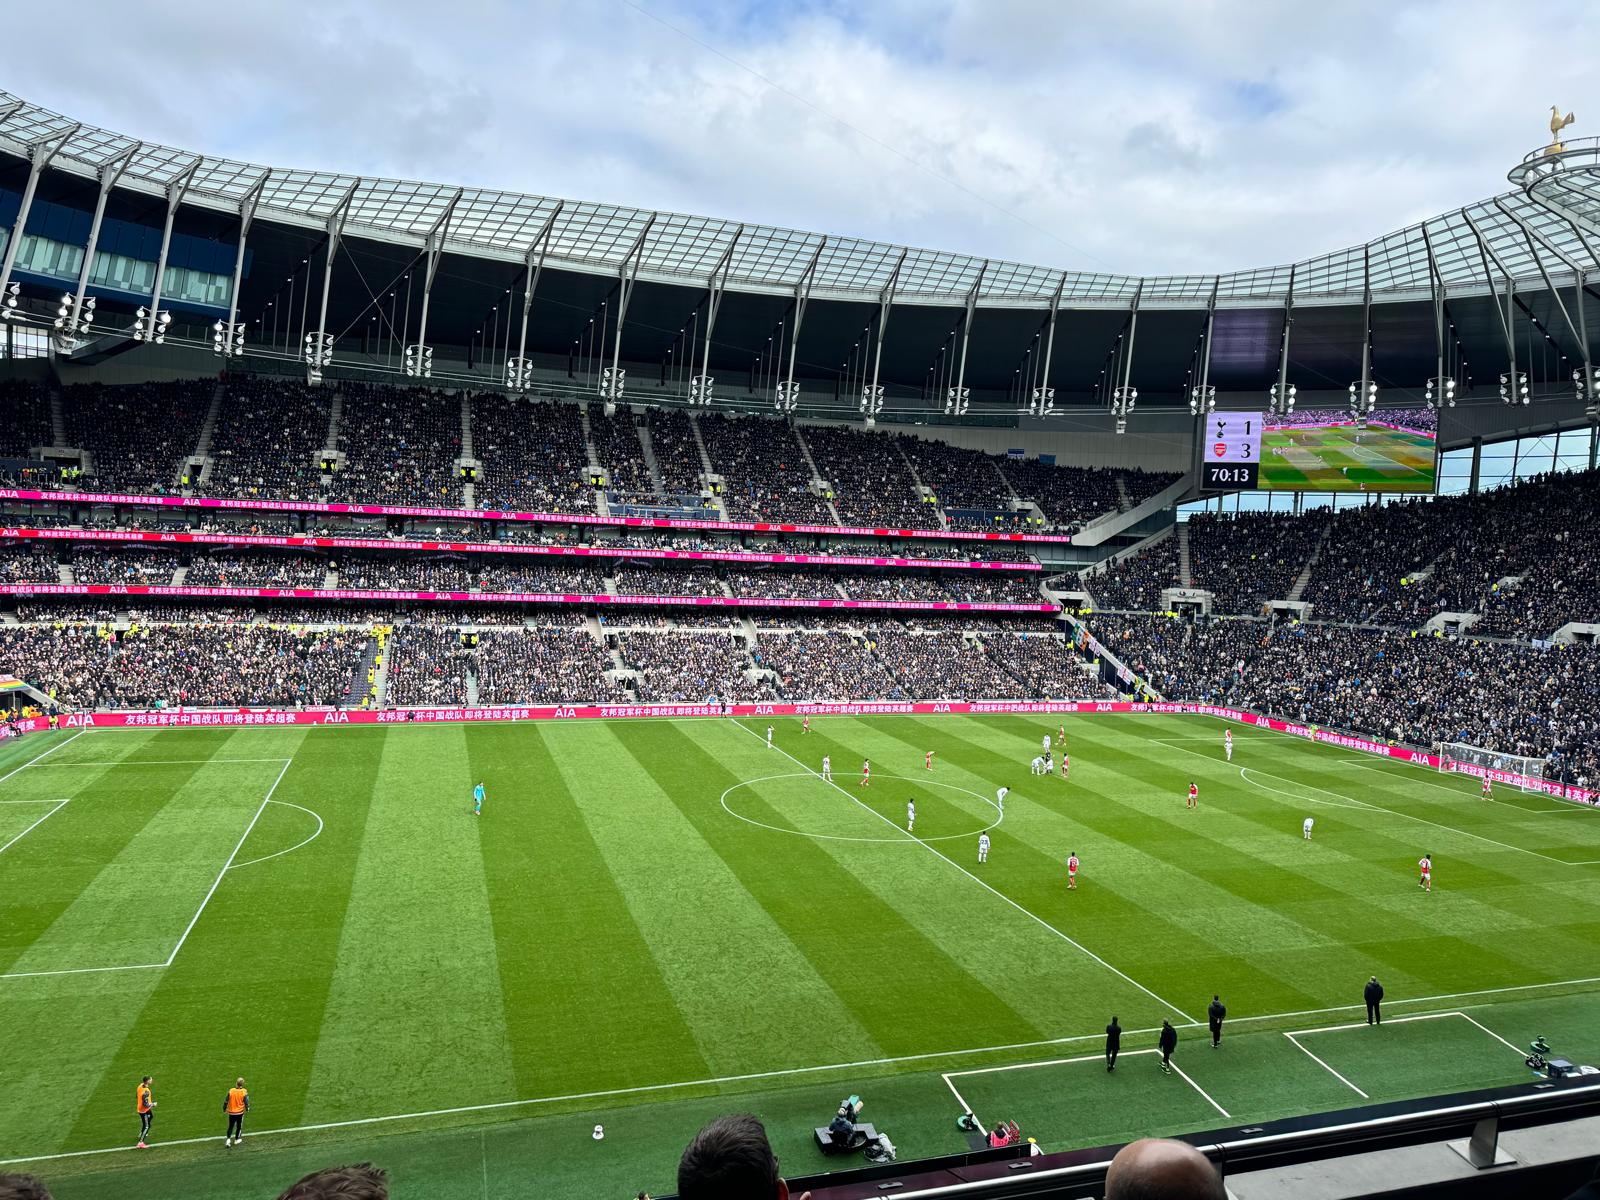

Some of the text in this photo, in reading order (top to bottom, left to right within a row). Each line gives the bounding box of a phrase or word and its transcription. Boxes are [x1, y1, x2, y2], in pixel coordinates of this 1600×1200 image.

[1244, 420, 1251, 435] 1
[1241, 443, 1251, 458] 3
[1211, 468, 1249, 482] 70:13
[0, 490, 19, 498] AIA
[183, 498, 200, 506] AIA
[347, 505, 364, 513] AIA
[501, 512, 517, 520] AIA
[640, 519, 655, 527] AIA
[0, 586, 88, 594] 中国战队即将登陆英超赛
[109, 586, 128, 594] AIA
[435, 592, 451, 600] AIA
[66, 714, 95, 726] AIA
[126, 713, 296, 725] 友邦冠军杯中国战队即将登陆英超赛
[324, 712, 349, 723] AIA
[377, 709, 529, 722] 友邦冠杯中国战队即将登陆英超赛
[554, 708, 576, 718] AIA
[754, 705, 774, 715] AIA
[932, 704, 951, 713] AIA
[1096, 703, 1112, 712] AIA
[1255, 717, 1271, 729] AIA
[1409, 752, 1430, 766] AIA
